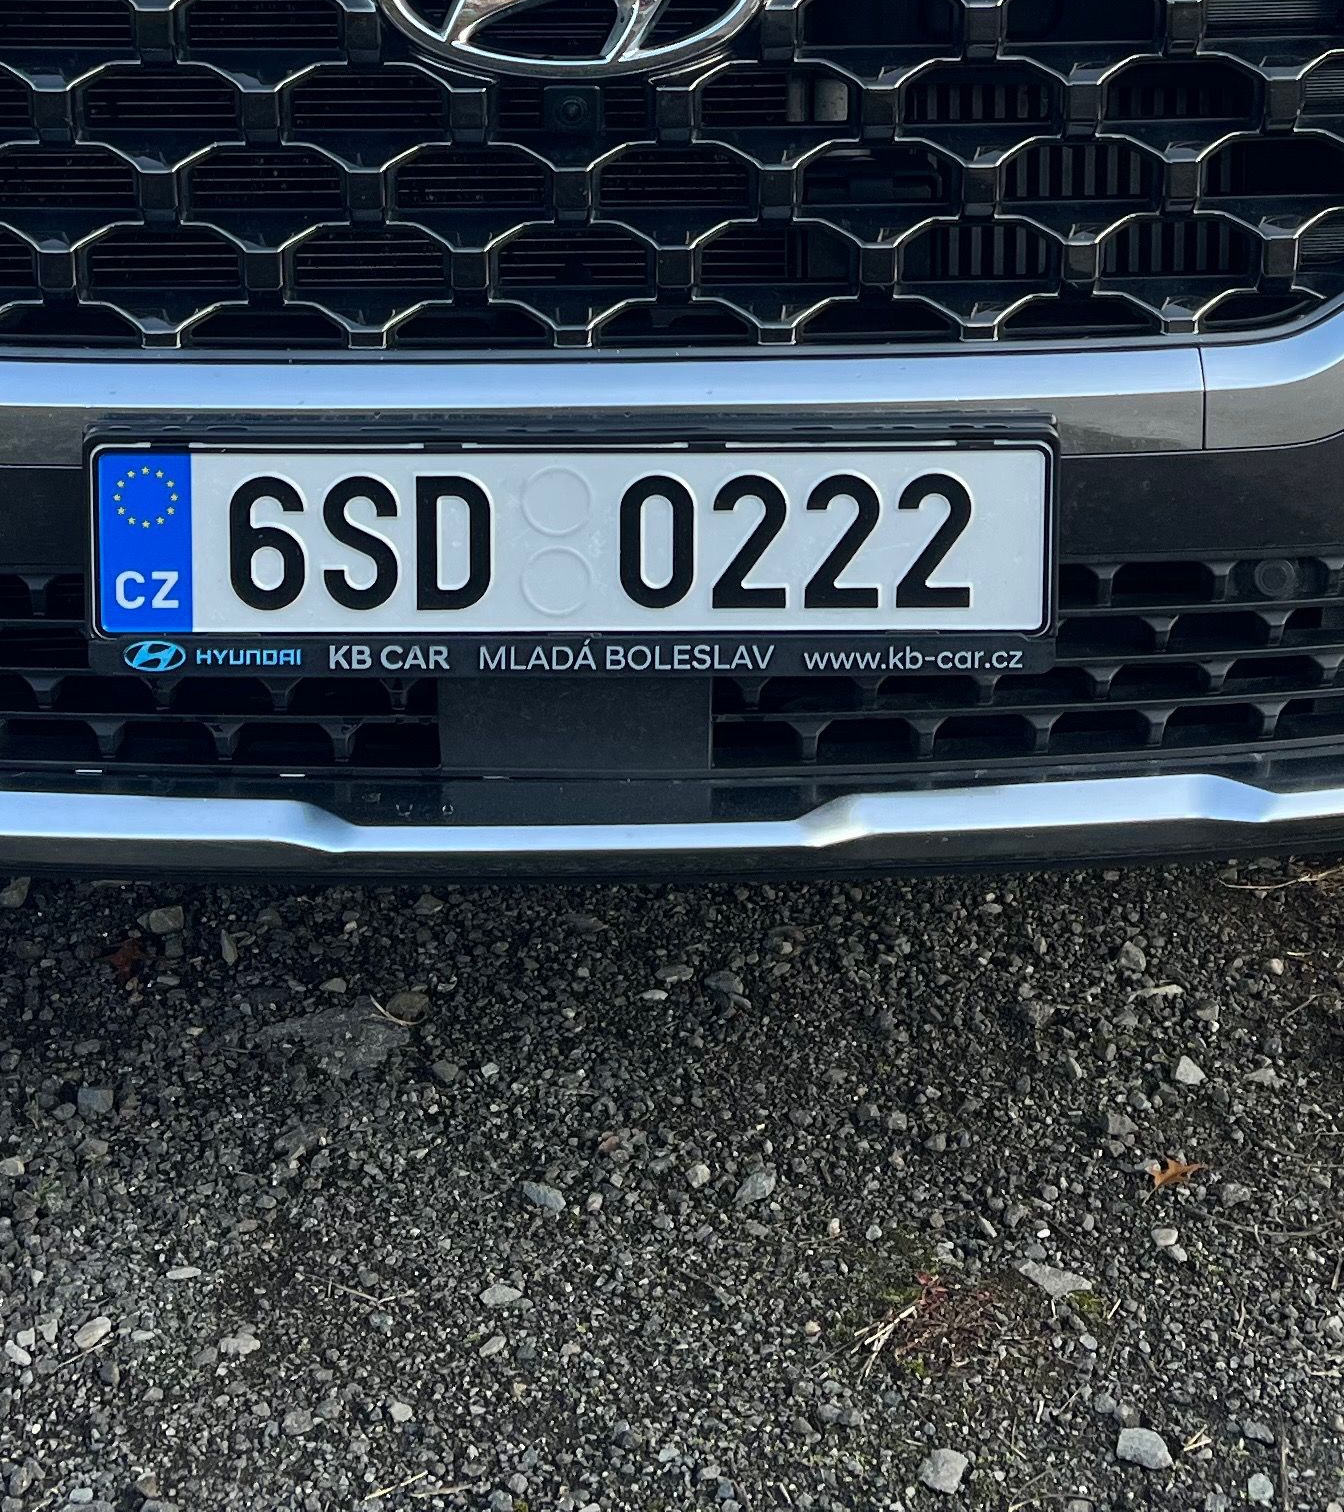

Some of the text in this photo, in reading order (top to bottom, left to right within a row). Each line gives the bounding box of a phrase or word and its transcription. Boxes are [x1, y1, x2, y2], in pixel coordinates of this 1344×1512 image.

[229, 472, 973, 611] 6SD 0222
[115, 570, 180, 610] CZ
[196, 640, 1023, 670] HYUNDAI KB CAR MLADÁ BOLESLAV www.kb-car.cz
